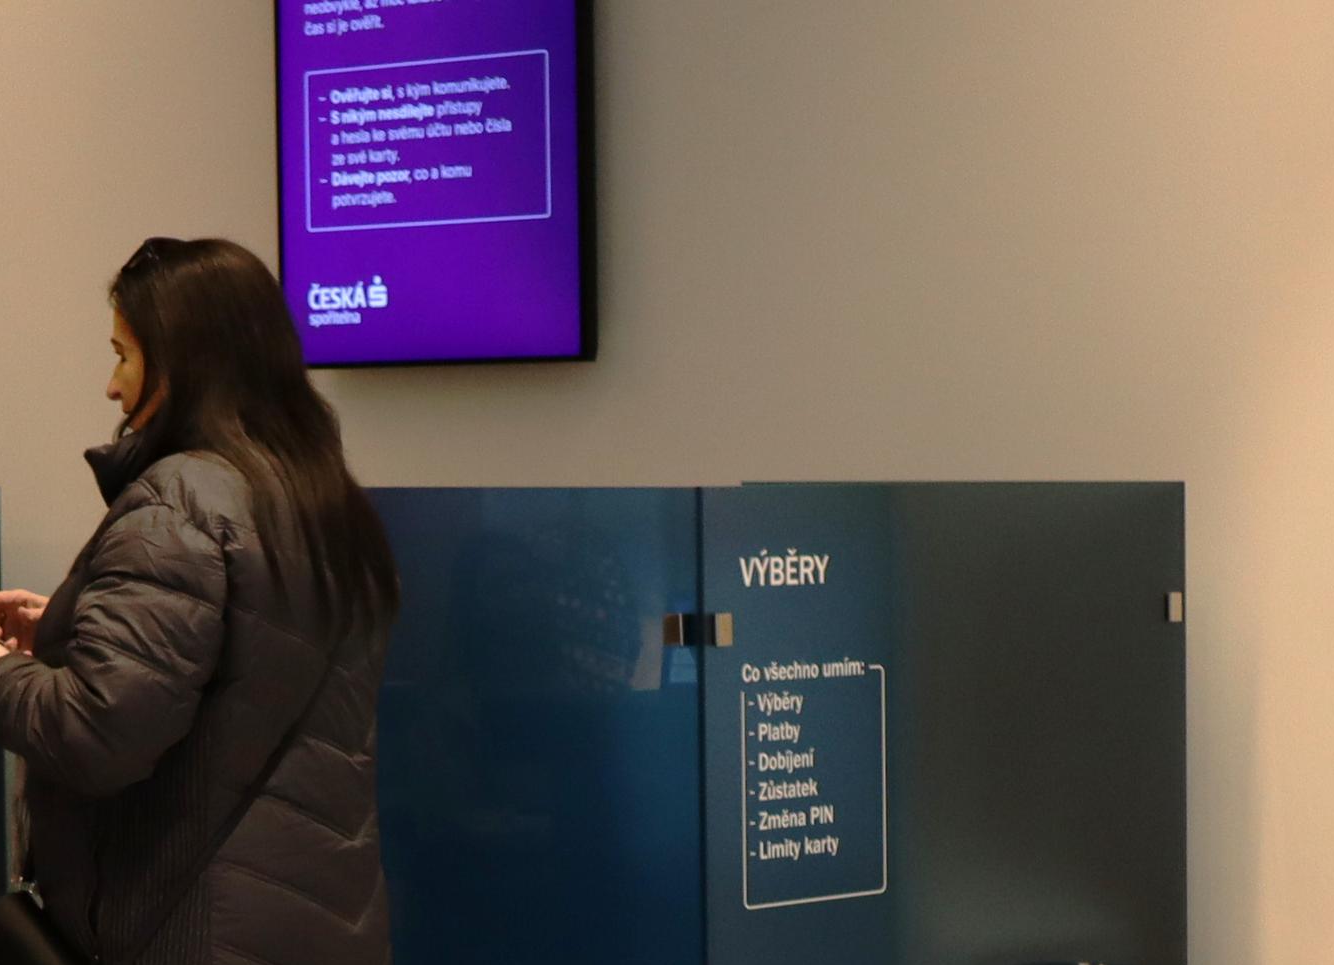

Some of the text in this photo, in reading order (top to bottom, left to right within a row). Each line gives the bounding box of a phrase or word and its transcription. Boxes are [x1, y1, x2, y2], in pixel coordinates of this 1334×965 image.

[337, 18, 349, 36] je
[396, 86, 405, 99] s
[330, 110, 340, 125] S
[331, 133, 340, 146] a
[412, 169, 429, 181] co
[430, 168, 439, 180] a
[307, 280, 367, 311] ČESKÁ
[308, 311, 362, 328] spořitelna
[739, 548, 830, 587] VÝBĚRY
[741, 656, 865, 683] Co všechno umím:
[757, 691, 804, 717] Výběry
[758, 721, 801, 743] Platby
[758, 747, 815, 774] Dobíjení
[758, 778, 819, 801] Zůstatek
[759, 809, 806, 831] Změna
[810, 804, 834, 825] PIN
[759, 838, 801, 861] Limity
[804, 835, 840, 856] karty
